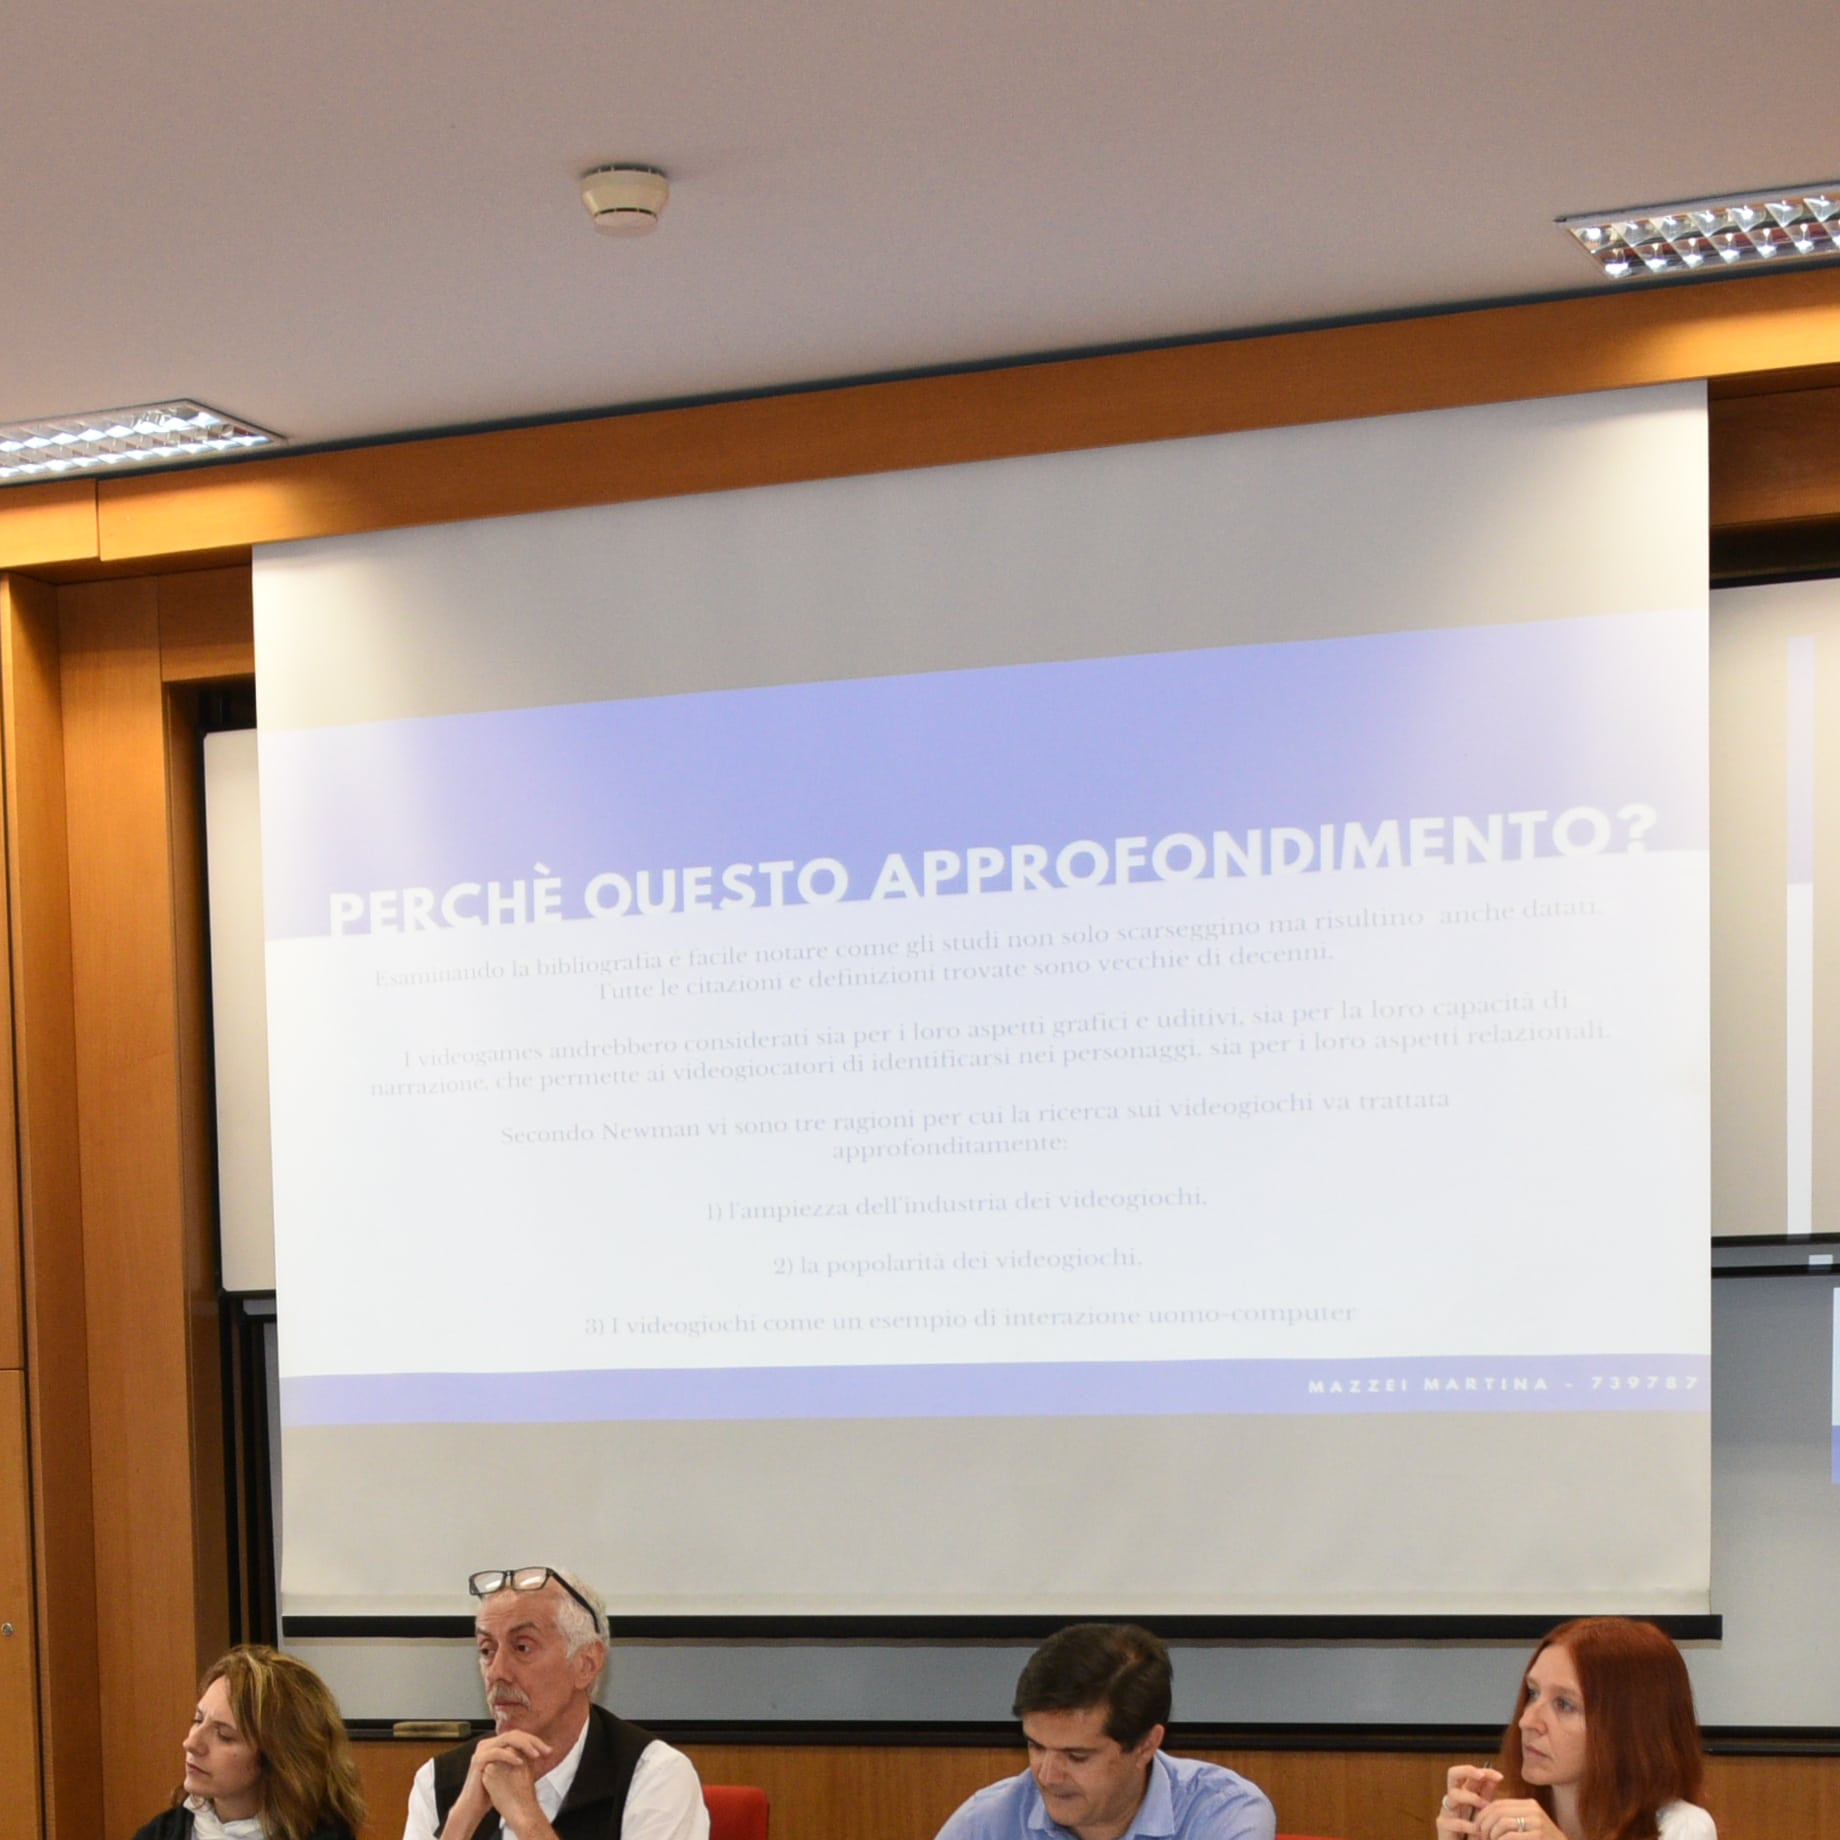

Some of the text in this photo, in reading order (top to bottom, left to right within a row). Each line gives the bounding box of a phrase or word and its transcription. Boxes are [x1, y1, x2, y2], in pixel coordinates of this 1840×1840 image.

[871, 804, 1656, 900] APPROFONDIMENTO?
[512, 959, 530, 977] la
[536, 951, 663, 977] bibliografia
[689, 945, 748, 967] facile
[755, 946, 829, 963] notare
[835, 942, 900, 958] come
[906, 933, 935, 959] gli
[942, 929, 999, 952] studi
[1007, 933, 1054, 949] non
[1061, 924, 1110, 945] solo
[1116, 916, 1261, 942] scarseggino
[1269, 917, 1308, 935] ma
[1314, 907, 1425, 931] risultino
[1439, 901, 1515, 925] anche
[599, 983, 654, 1001] Tutte
[661, 977, 680, 998] le
[686, 972, 783, 995] citazioni
[808, 966, 935, 989] definizioni
[943, 963, 1027, 982] trovate
[1033, 960, 1091, 976] sono
[1098, 949, 1190, 972] vecchie
[1196, 947, 1221, 967] di
[418, 1047, 544, 1067] videogames
[549, 1036, 678, 1060] andrebbero
[684, 1027, 809, 1052] considerati
[816, 1025, 846, 1046] sia
[853, 1028, 893, 1048] per
[913, 1021, 961, 1041] loro
[967, 1015, 1045, 1042] aspetti
[1052, 1011, 1128, 1039] grafici
[1252, 1004, 1284, 1025] sia
[1292, 1006, 1331, 1028] per
[1341, 999, 1363, 1021] la
[1371, 999, 1425, 1019] loro
[1543, 989, 1568, 1009] di
[495, 1071, 533, 1089] che
[540, 1069, 640, 1093] permette
[647, 1063, 665, 1083] ai
[672, 1055, 835, 1083] videogiocatori
[842, 1054, 864, 1073] di
[871, 1049, 1011, 1072] identificarsi
[1019, 1044, 1055, 1065] nei
[1209, 1037, 1243, 1056] sia
[1250, 1039, 1292, 1060] per
[1314, 1031, 1366, 1052] loro
[1374, 1026, 1459, 1055] aspetti
[501, 1091, 1451, 1145] Secondo Newman vi sono tre ragioni per cui la ricerca sui videogiochi va trattata
[1015, 1191, 1051, 1210] dei
[772, 1257, 794, 1276] 2)
[800, 1255, 820, 1275] la
[951, 1250, 988, 1270] dei
[584, 1317, 605, 1337] 3)
[626, 1313, 757, 1337] videogiochi
[762, 1317, 825, 1333] come
[832, 1316, 862, 1331] un
[868, 1314, 968, 1333] esempio
[973, 1307, 996, 1328] di
[1004, 1306, 1141, 1327] interazione
[1148, 1306, 1357, 1327] uomo-computer
[1307, 1379, 1407, 1394] MAZZEI
[1423, 1376, 1549, 1392] MARTINA
[1590, 1376, 1699, 1391] 739787
